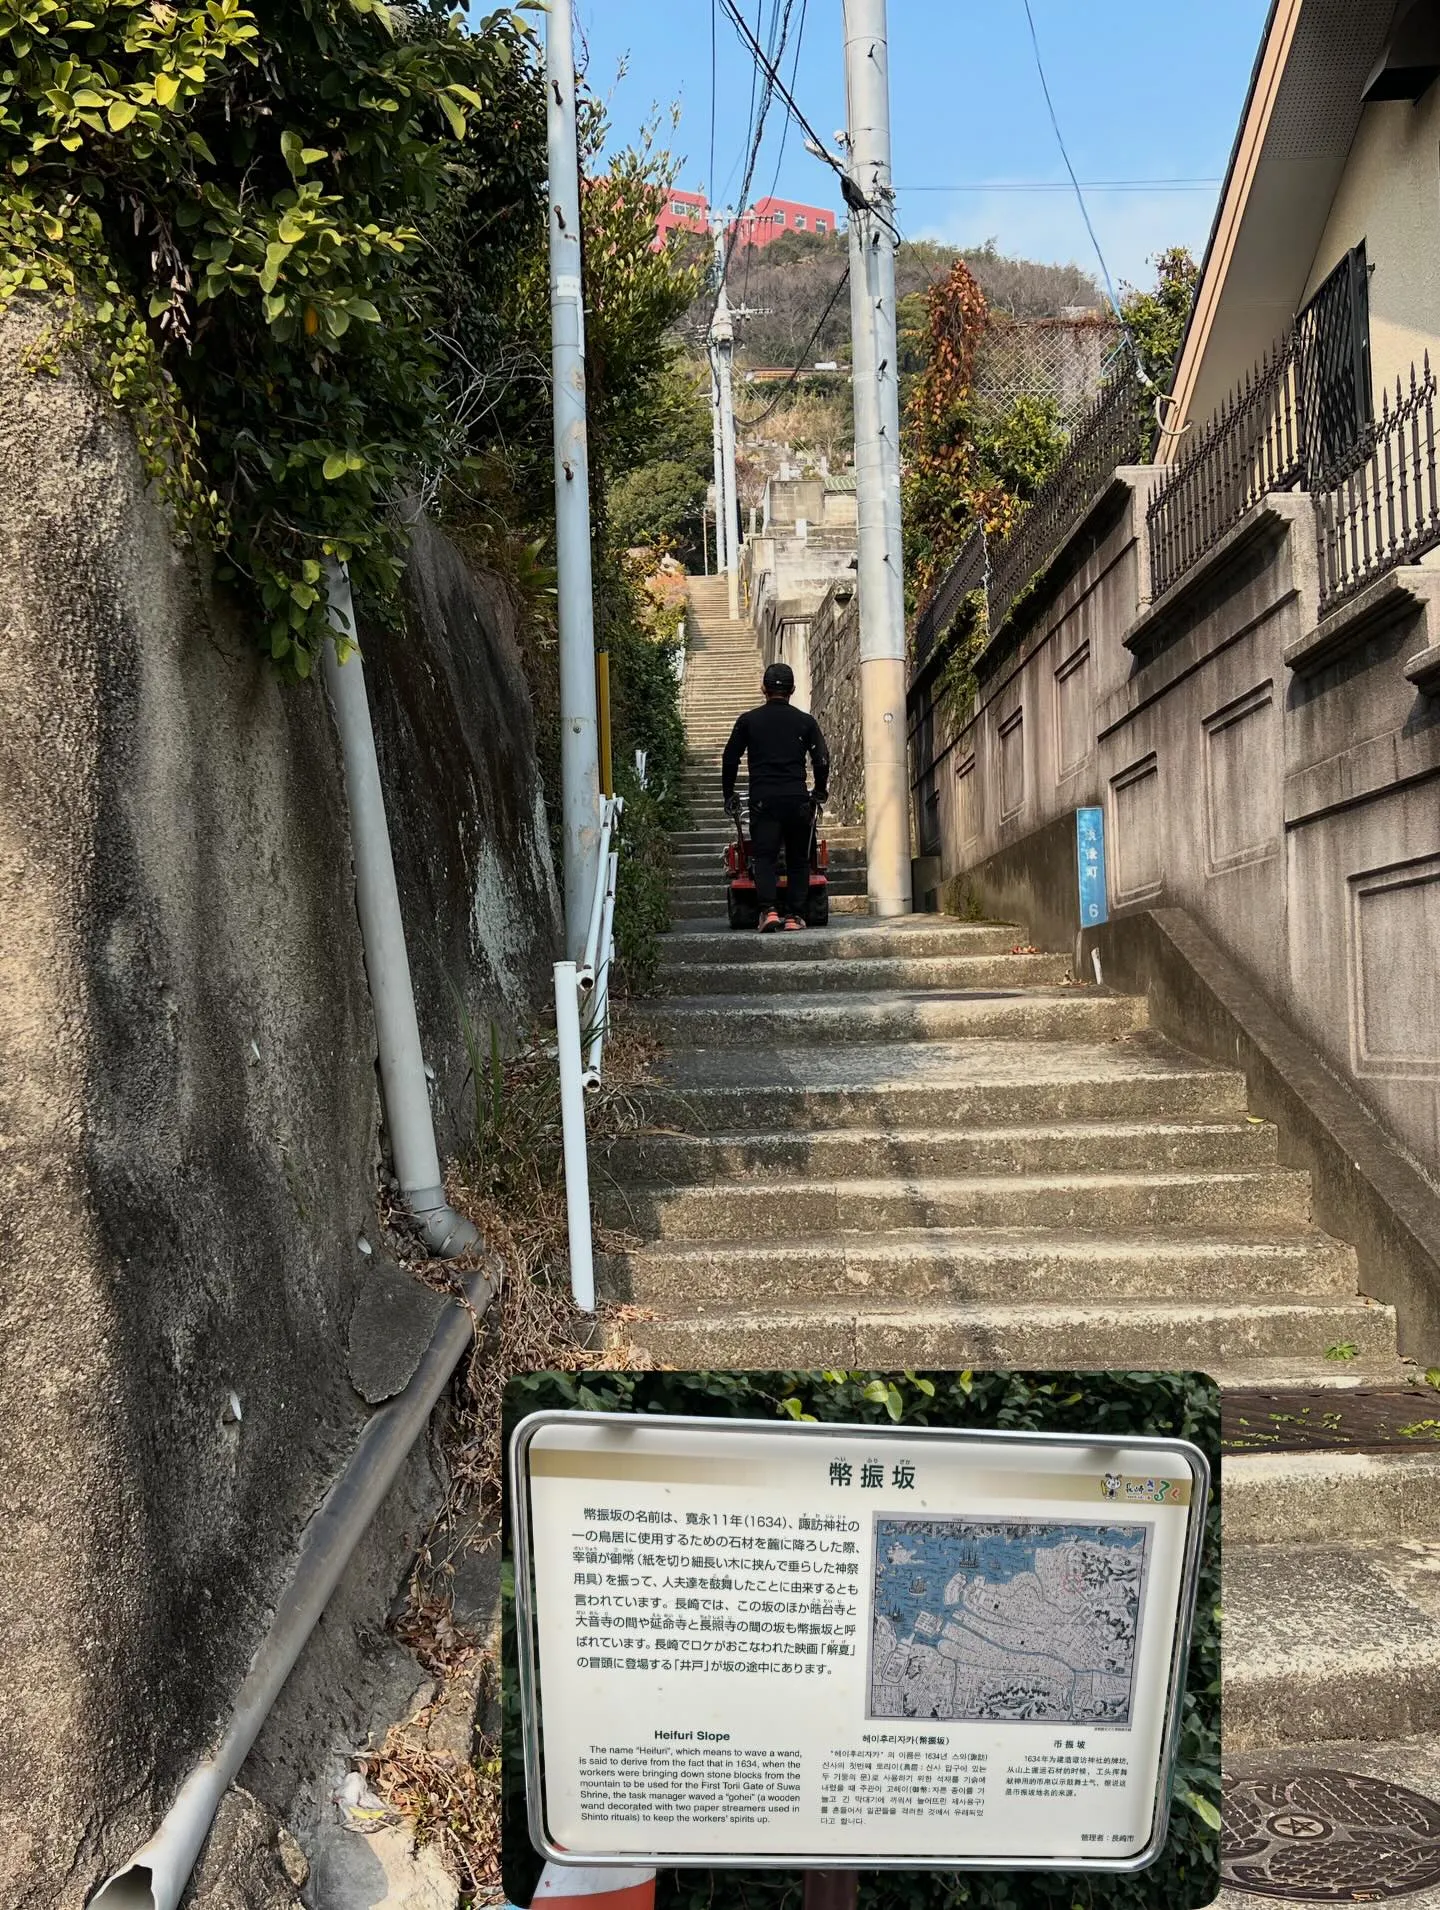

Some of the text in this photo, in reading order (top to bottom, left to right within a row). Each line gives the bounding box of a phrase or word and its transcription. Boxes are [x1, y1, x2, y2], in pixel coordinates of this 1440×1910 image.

[1088, 903, 1099, 918] 6
[829, 1462, 916, 1490] 幣振坂
[654, 1730, 731, 1742] Heifuri Slope
[589, 1745, 606, 1754] The
[676, 1747, 700, 1755] which
[734, 1748, 742, 1756] to
[777, 1748, 802, 1758] wand,
[925, 1752, 948, 1760] 1634년
[579, 1756, 801, 1768] is said to derive from the fact that in 1634, when the
[579, 1768, 616, 1777] workers
[642, 1769, 678, 1780] bringing
[680, 1770, 705, 1778] down
[707, 1770, 732, 1779] stone
[734, 1771, 762, 1779] blocks
[765, 1771, 785, 1780] from
[787, 1772, 801, 1780] the
[579, 1779, 801, 1791] mountain to be used for the First Torii Gate of Suwa
[580, 1790, 611, 1800] Shrine,
[613, 1791, 627, 1799] the
[629, 1791, 646, 1799] task
[649, 1793, 686, 1802] manager
[689, 1792, 716, 1800] waved
[757, 1793, 766, 1803] (a
[768, 1793, 800, 1802] wooden
[580, 1801, 800, 1814] wand decorated with two paper streamers used in
[581, 1812, 609, 1821] Shinto
[611, 1813, 640, 1823] rituals)
[643, 1813, 651, 1821] to
[653, 1813, 674, 1824] keep
[676, 1814, 690, 1822] the
[730, 1814, 755, 1825] spirits
[757, 1816, 770, 1825] up.
